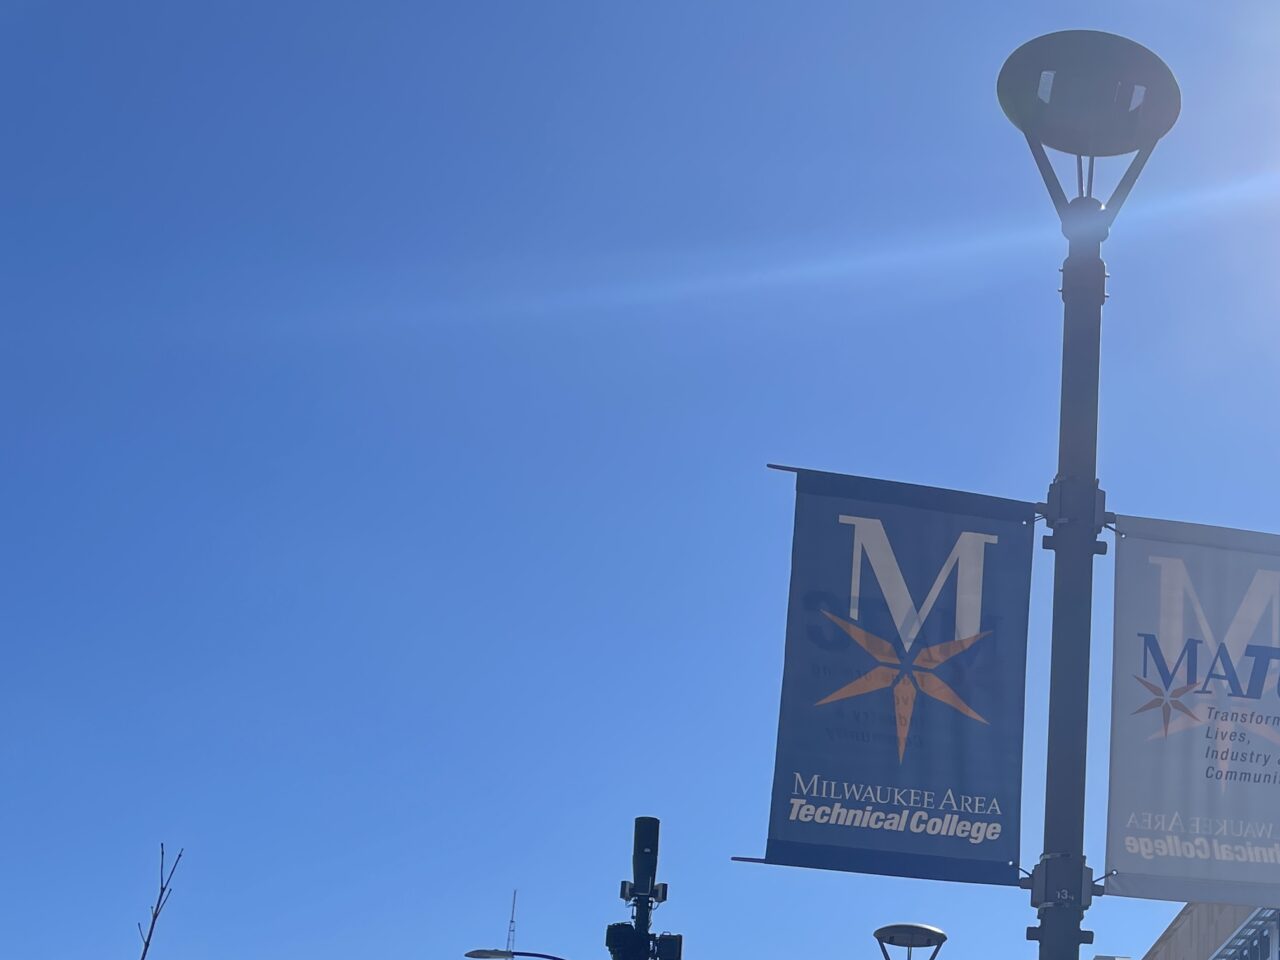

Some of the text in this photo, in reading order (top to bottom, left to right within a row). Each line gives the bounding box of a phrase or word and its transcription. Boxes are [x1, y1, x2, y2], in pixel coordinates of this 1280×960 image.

[838, 514, 998, 653] M
[1205, 726, 1252, 745] Lives,
[1205, 746, 1272, 767] Industry
[791, 772, 1002, 815] MILWAUKEE AREA
[789, 799, 1002, 844] Technical College
